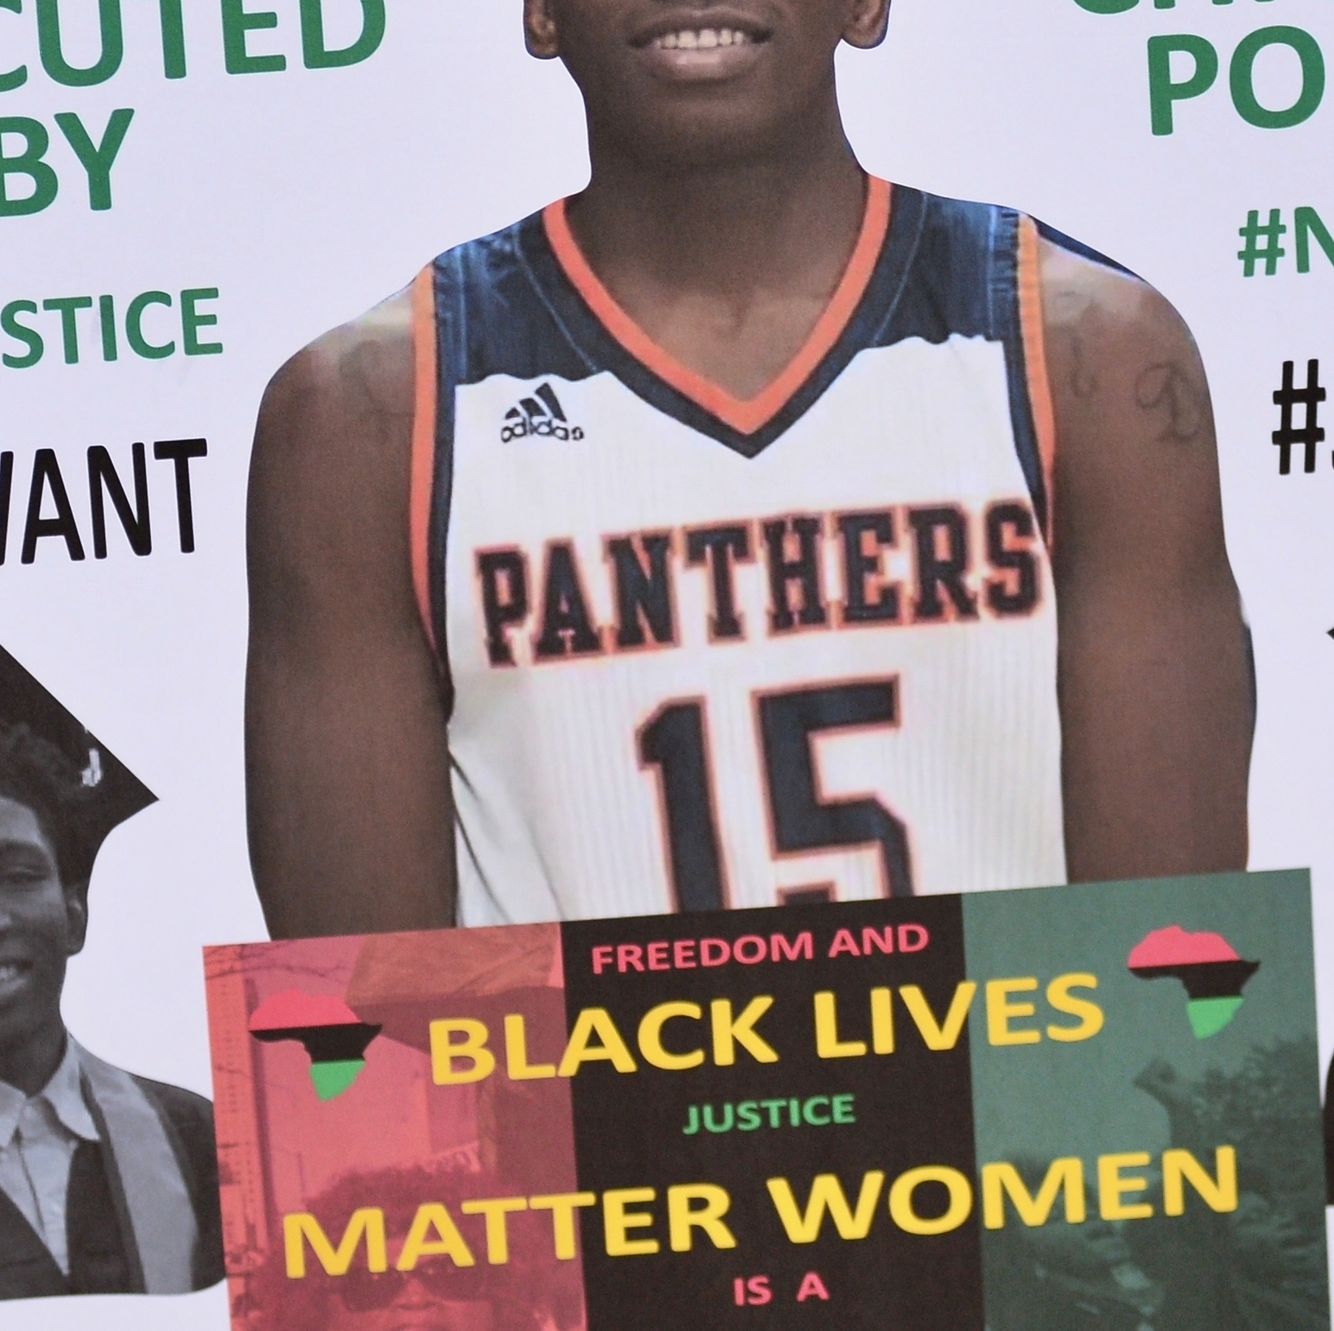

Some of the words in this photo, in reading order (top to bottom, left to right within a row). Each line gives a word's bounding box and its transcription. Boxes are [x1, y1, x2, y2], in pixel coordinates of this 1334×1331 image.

[475, 500, 1046, 667] PANTHERS
[635, 674, 917, 919] 15
[592, 931, 813, 974] FREEDOM
[829, 924, 929, 957] AND
[429, 995, 775, 1086] BLACK
[813, 973, 1104, 1057] LIVES
[683, 1095, 855, 1134] JUSTICE
[282, 1183, 735, 1278] MATTER
[767, 1145, 1237, 1244] WOMEN
[734, 1276, 772, 1305] IS
[797, 1272, 829, 1301] A
